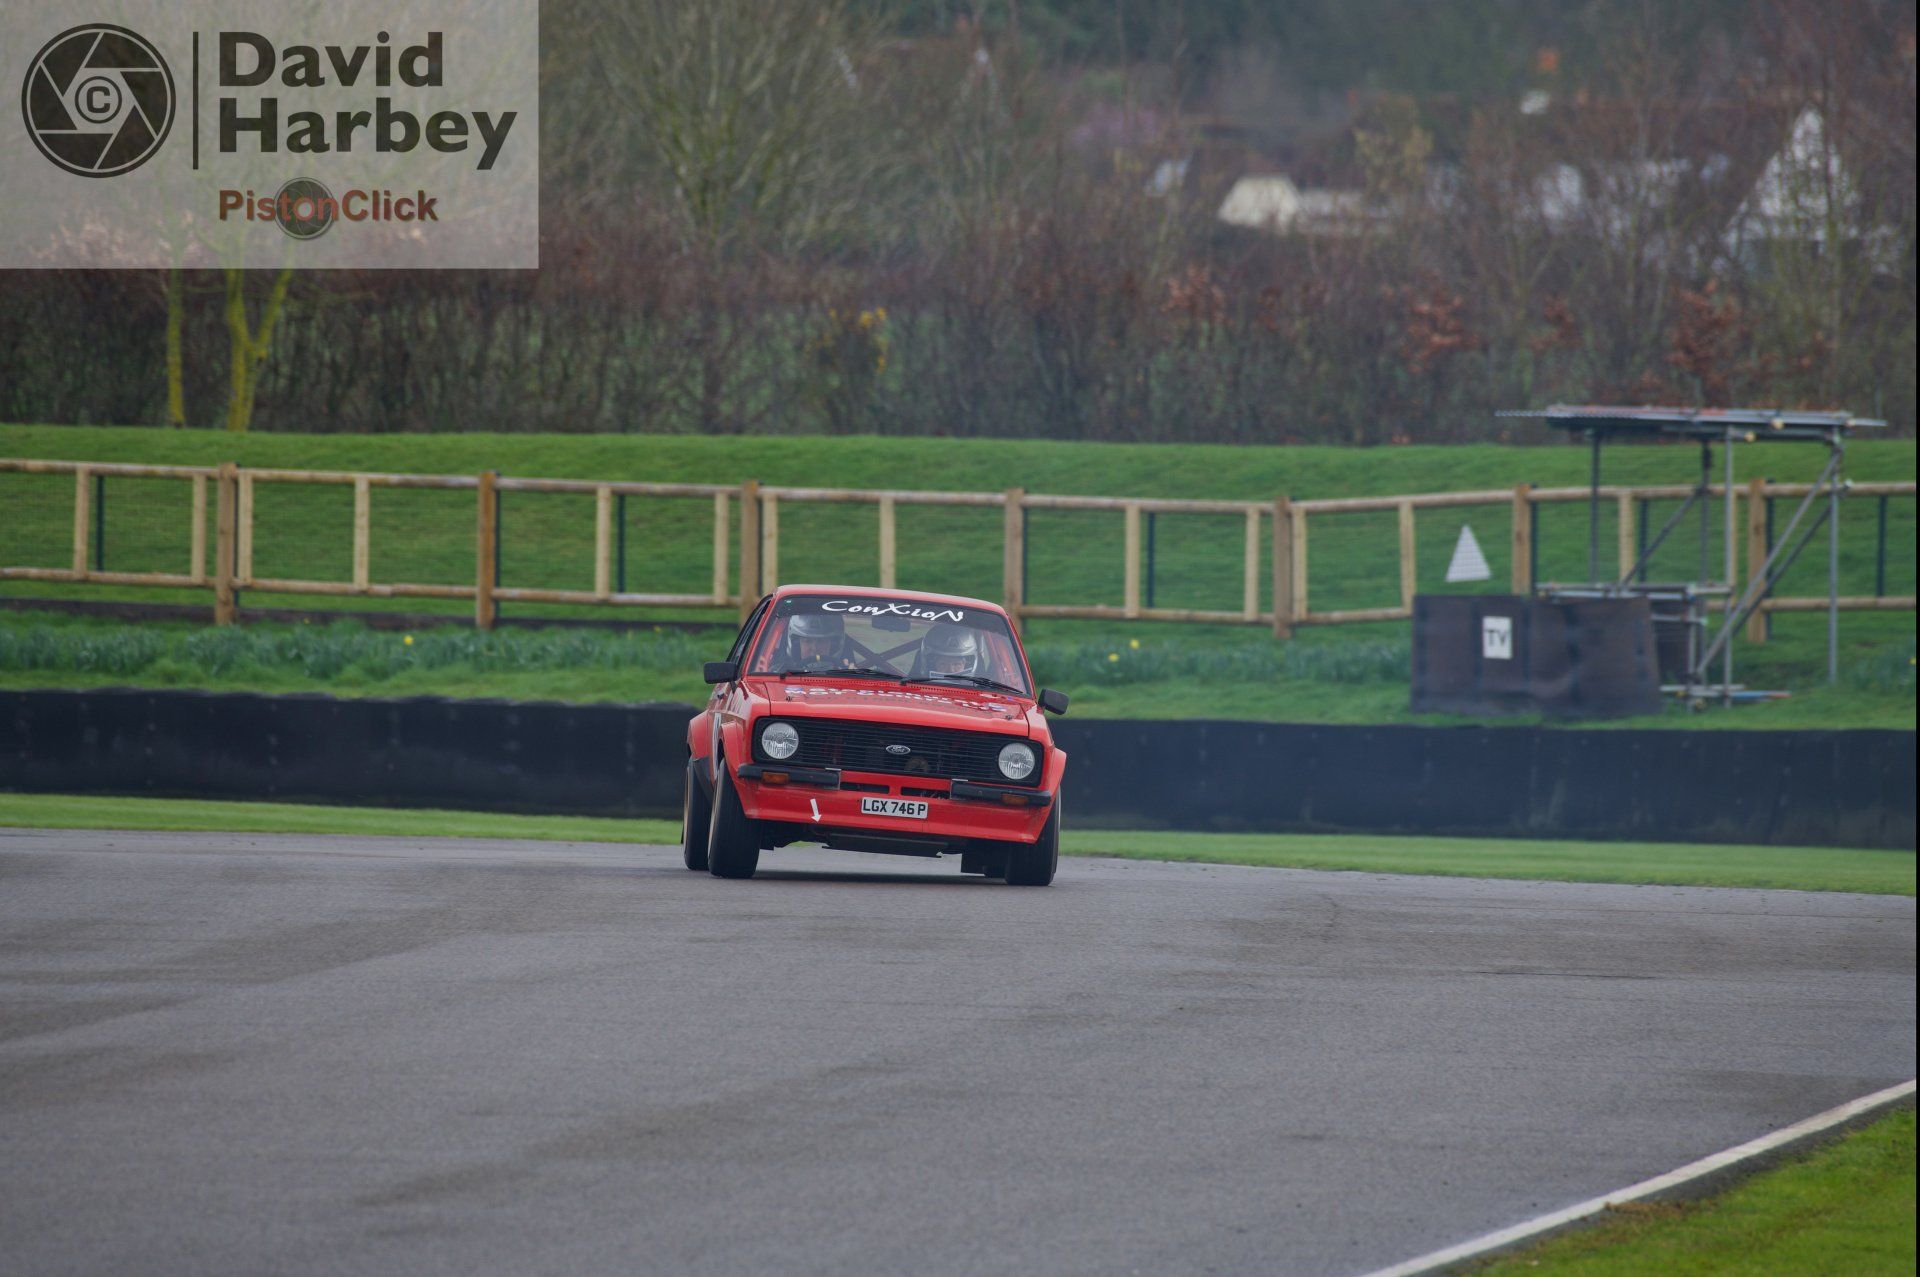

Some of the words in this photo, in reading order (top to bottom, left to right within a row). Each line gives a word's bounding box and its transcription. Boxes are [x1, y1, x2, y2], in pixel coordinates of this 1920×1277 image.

[1484, 628, 1509, 647] TV
[862, 799, 888, 813] LGX
[891, 801, 915, 815] 746
[917, 804, 926, 816] P
